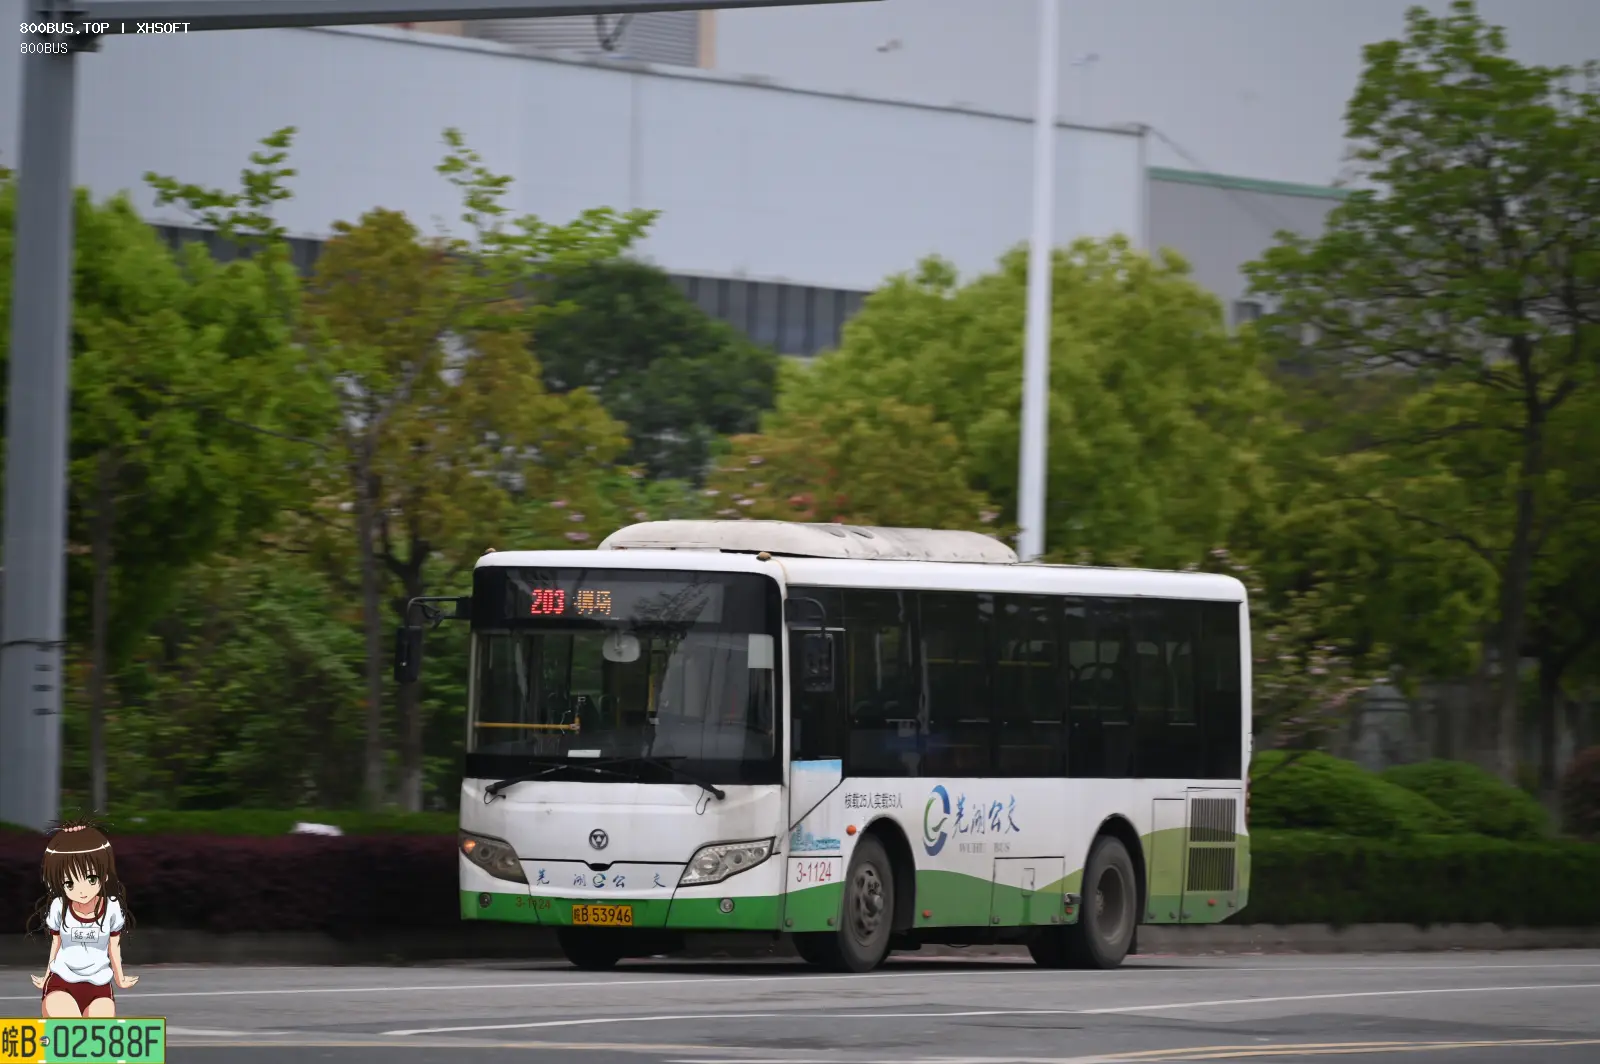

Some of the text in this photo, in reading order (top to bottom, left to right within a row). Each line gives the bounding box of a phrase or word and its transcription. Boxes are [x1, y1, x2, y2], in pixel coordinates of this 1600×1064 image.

[531, 589, 565, 615] 203
[844, 791, 903, 809] 核载25人实载53人
[951, 791, 1021, 840] 芜湖公交
[796, 861, 832, 883] 3-1124
